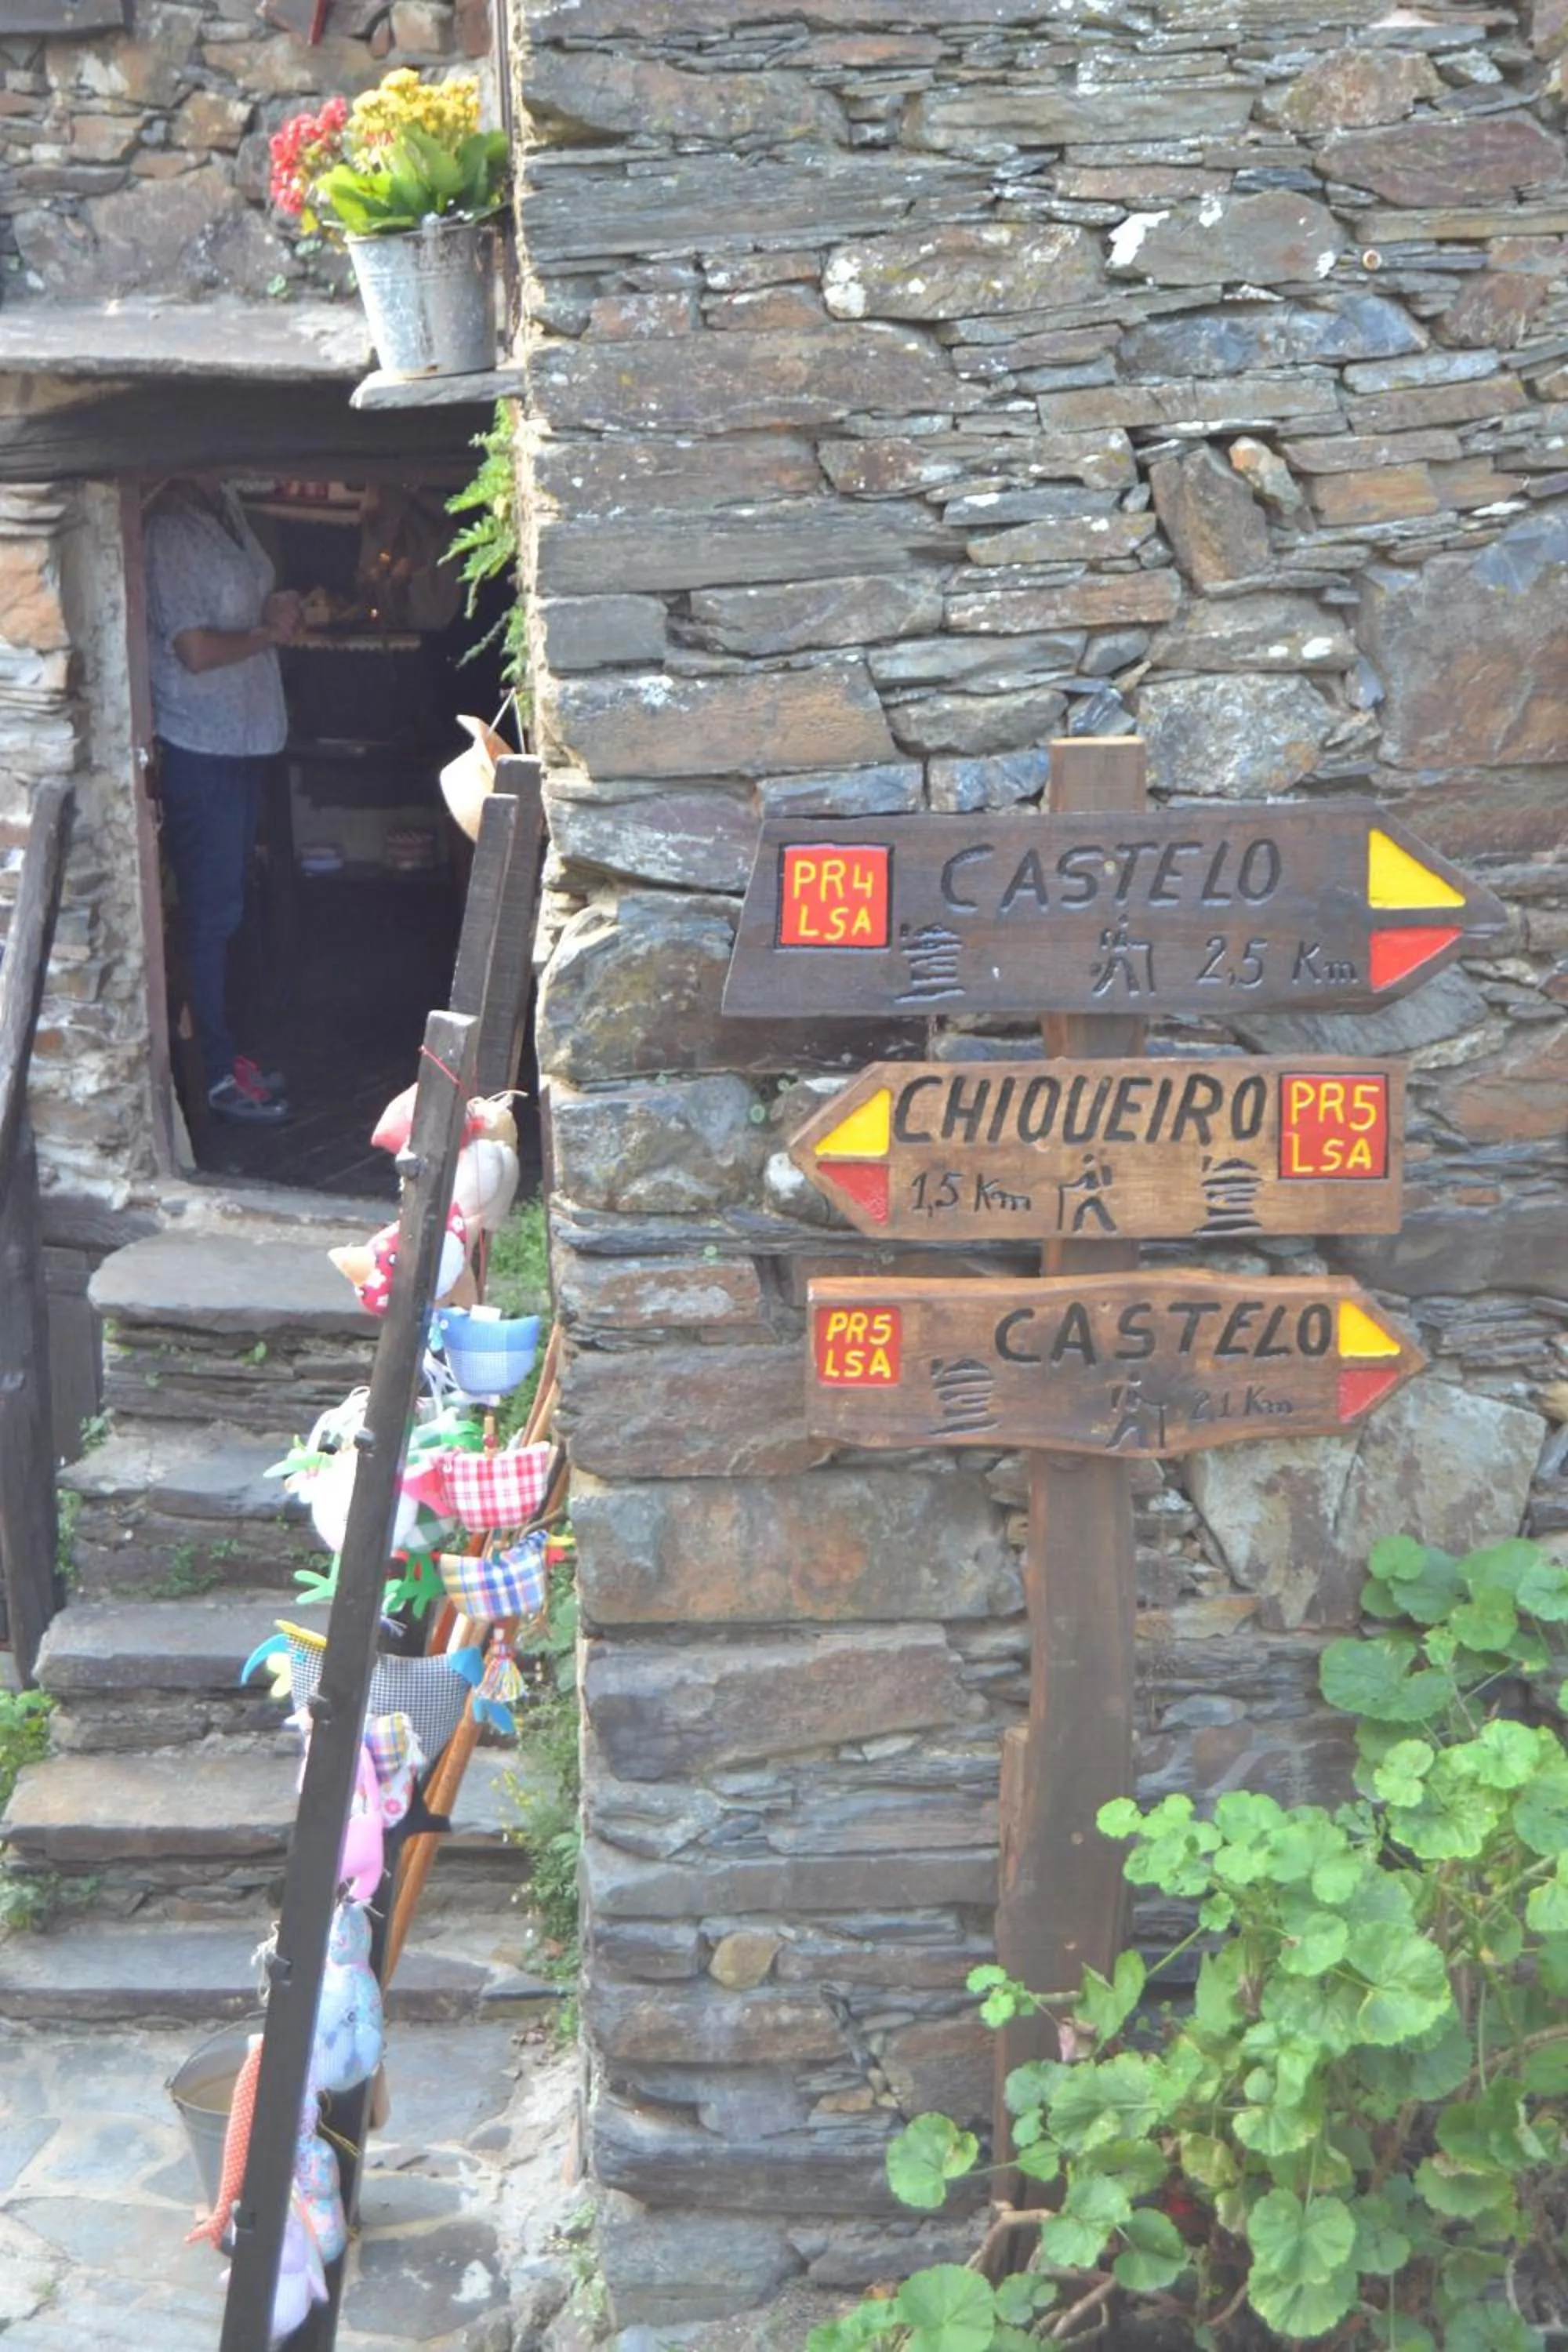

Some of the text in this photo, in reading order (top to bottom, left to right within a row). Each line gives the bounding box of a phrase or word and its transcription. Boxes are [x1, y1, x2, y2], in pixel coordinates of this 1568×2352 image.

[793, 859, 874, 902] PR4
[942, 838, 1282, 914] CASTELO
[799, 906, 872, 940] LSA
[1292, 940, 1360, 985] Km
[1290, 1080, 1381, 1131] PR5
[1290, 1132, 1373, 1174] LSA
[973, 1173, 1032, 1213] Km
[826, 1311, 892, 1346] PR5
[995, 1301, 1332, 1367] CASTELO
[826, 1348, 891, 1379] LSA
[1245, 1385, 1293, 1417] Km
